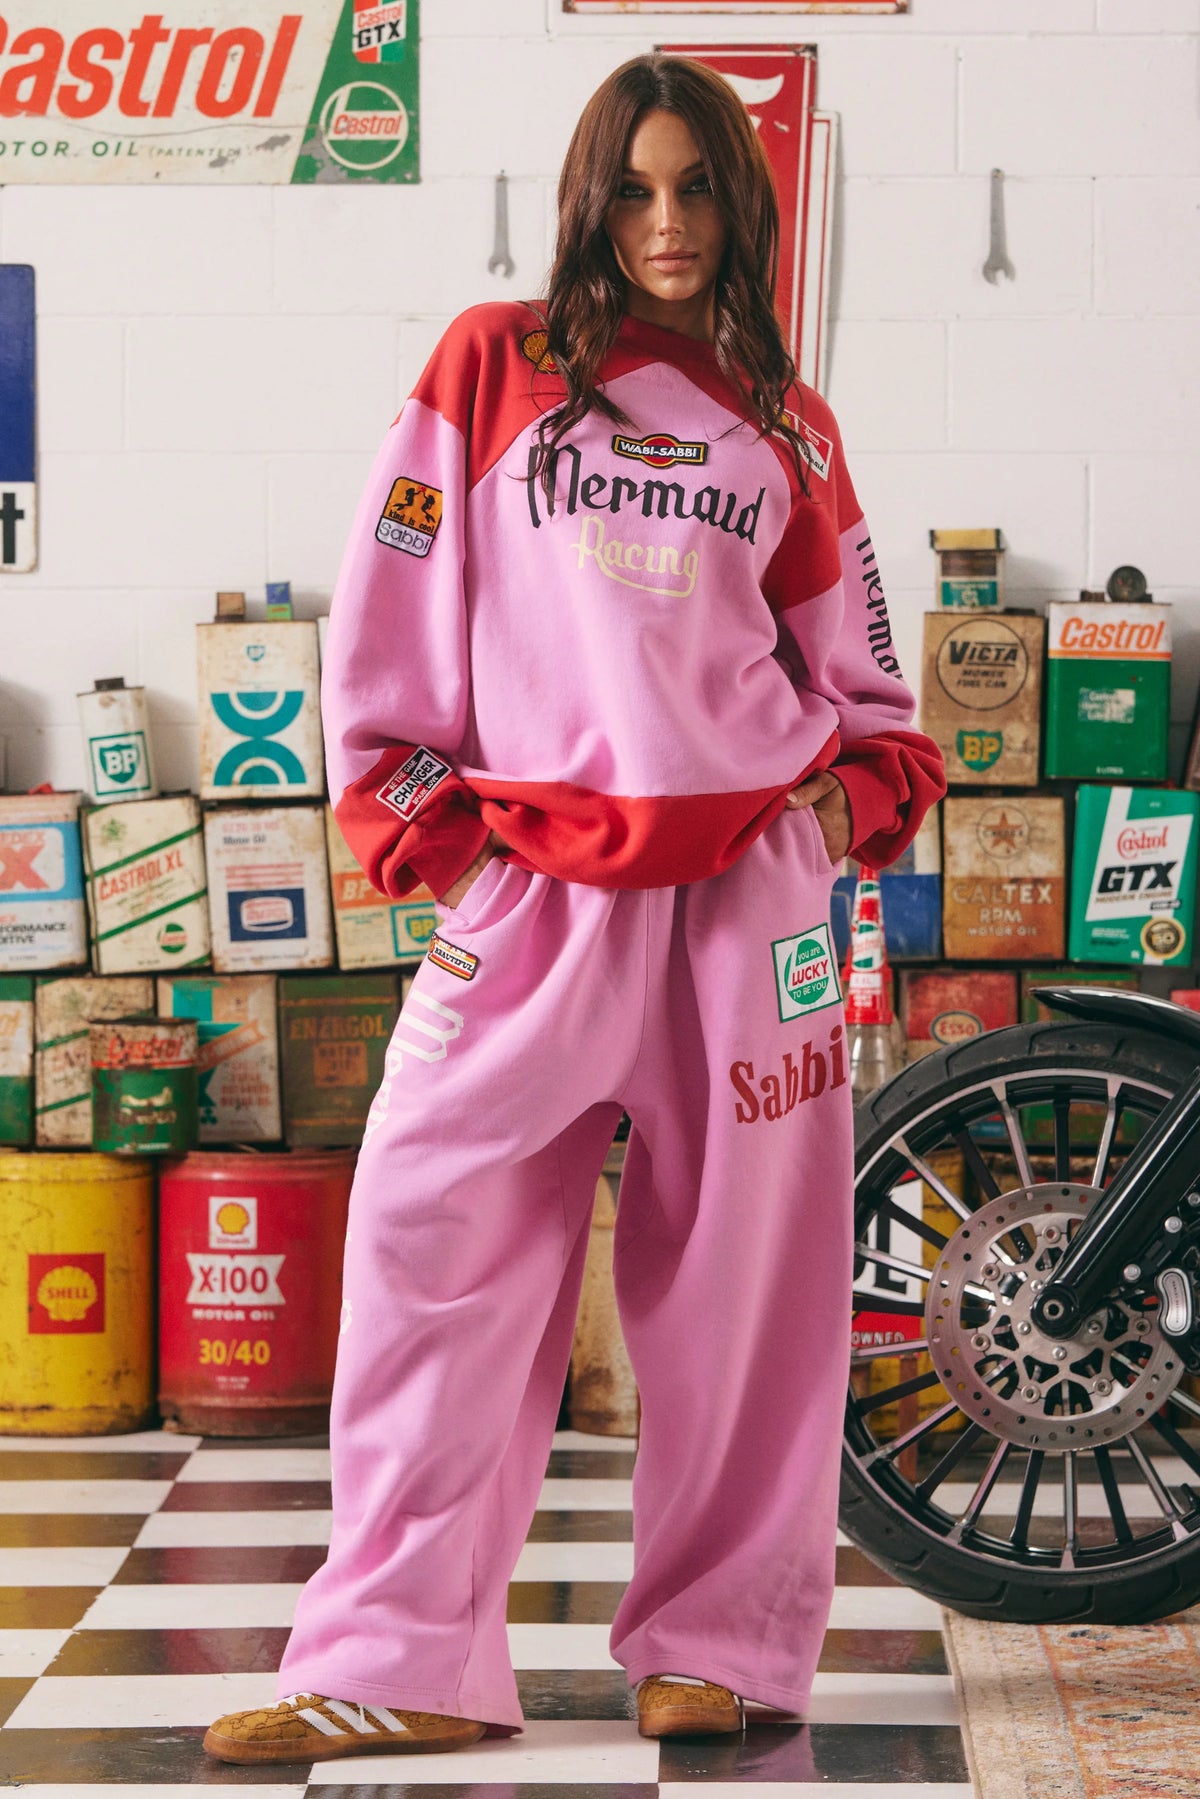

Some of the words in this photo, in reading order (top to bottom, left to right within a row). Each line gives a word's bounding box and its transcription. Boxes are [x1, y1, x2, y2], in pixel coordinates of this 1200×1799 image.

[356, 3, 403, 28] Castrol
[358, 19, 400, 49] GTX
[0, 15, 302, 118] astrol
[332, 113, 402, 136] Castrol
[92, 141, 138, 157] OIL
[620, 441, 697, 457] WABI-SABBI
[528, 443, 766, 545] Mermaid
[388, 509, 405, 522] kind
[408, 517, 416, 526] is
[418, 522, 435, 534] cool
[379, 521, 430, 552] Sabbi
[570, 515, 699, 598] Racing
[1059, 617, 1166, 650] Castrol
[949, 641, 1018, 665] VICTA
[963, 735, 1000, 762] BP
[104, 749, 137, 776] BP
[388, 782, 398, 791] BE
[396, 771, 407, 784] THE
[404, 759, 418, 773] GAME
[394, 760, 437, 805] CHANGER
[412, 788, 429, 805] SPARK
[425, 776, 439, 789] LOVE
[1117, 825, 1169, 860] Castrol
[99, 857, 162, 900] CASTROL
[164, 849, 185, 873] XL
[1097, 861, 1178, 893] GTX
[953, 883, 1053, 904] CALTEX
[410, 918, 435, 938] BP
[980, 907, 1022, 923] RPM
[967, 927, 1013, 937] MOTOR
[435, 948, 474, 971] BEAUTIFUL
[798, 950, 810, 963] you
[810, 946, 821, 956] are
[792, 959, 828, 987] LUCKY
[793, 990, 802, 999] TO
[803, 987, 811, 995] BE
[812, 979, 827, 992] YOU
[108, 1034, 185, 1060] Castrol
[730, 1024, 846, 1124] Sabbi
[199, 1265, 268, 1294] X-100
[47, 1287, 90, 1300] SHELL
[192, 1308, 246, 1321] MOTOR
[250, 1310, 275, 1321] OIL
[199, 1338, 271, 1367] 30/40
